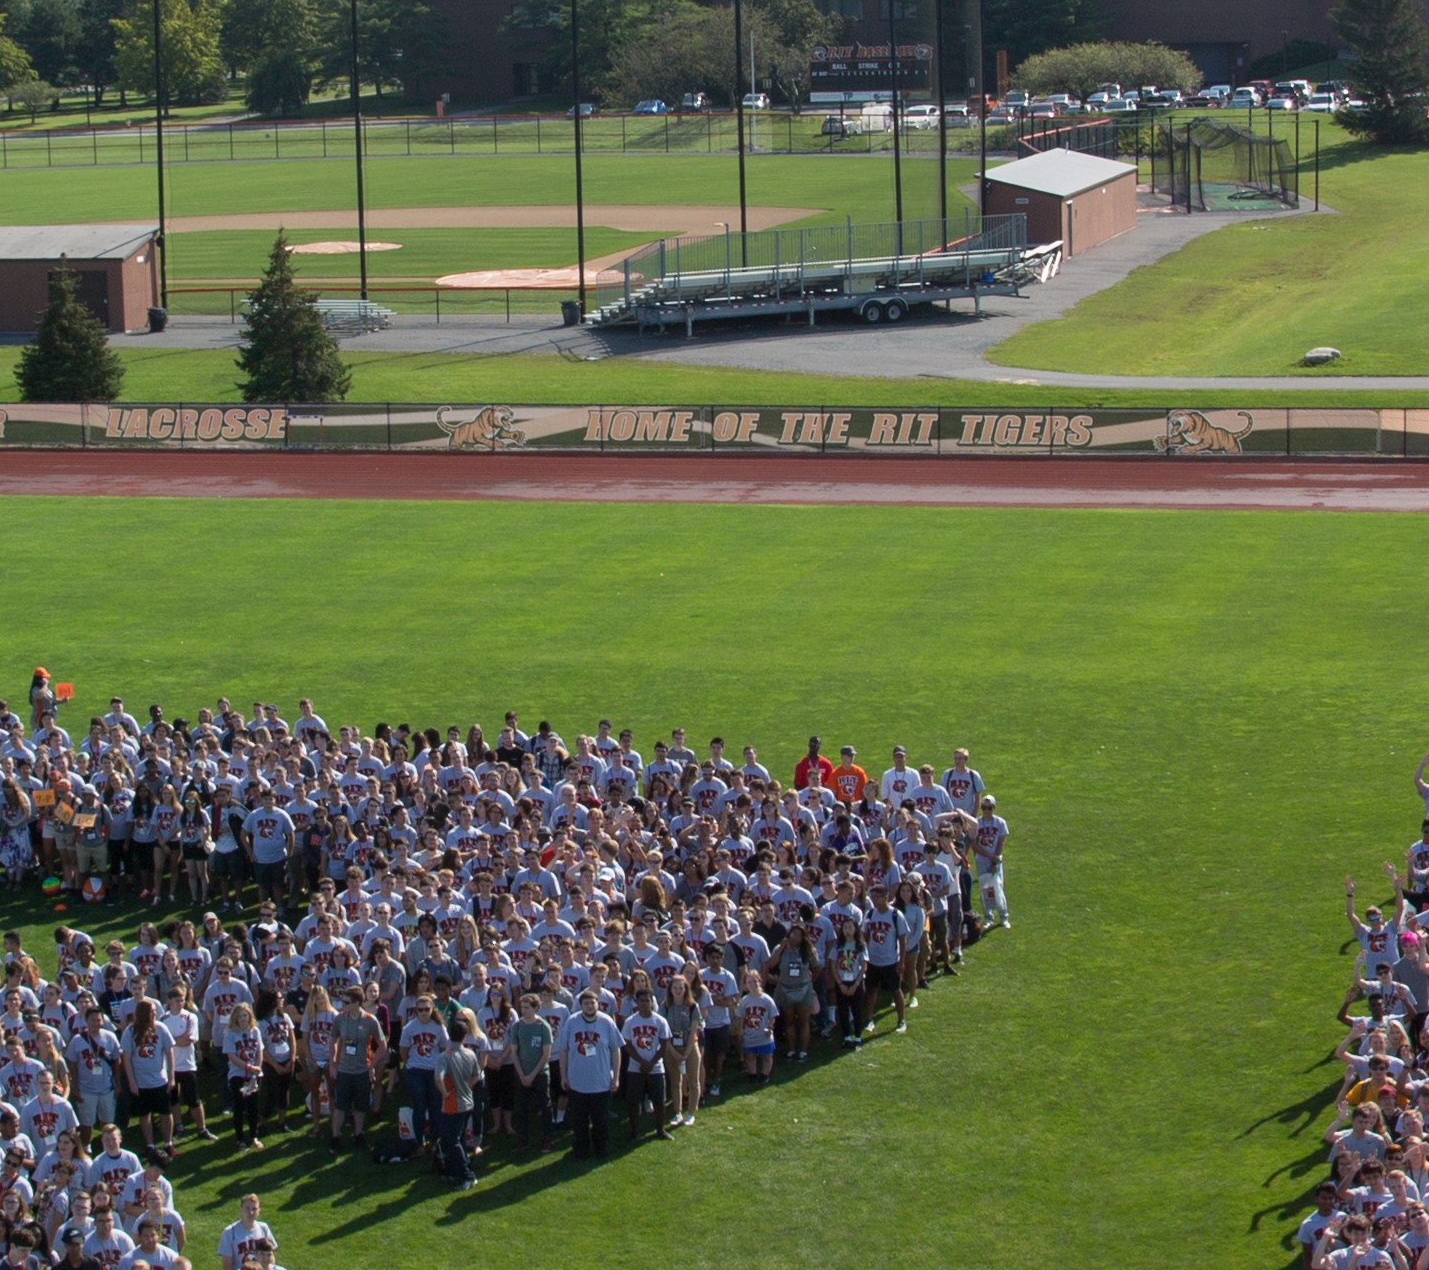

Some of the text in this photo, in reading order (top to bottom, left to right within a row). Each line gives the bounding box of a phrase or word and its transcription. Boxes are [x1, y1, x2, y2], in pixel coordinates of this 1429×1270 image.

[858, 61, 879, 69] STRIKE
[105, 407, 289, 441] LACROSSE
[585, 410, 1095, 449] HOME OF THE RIT TIGERS
